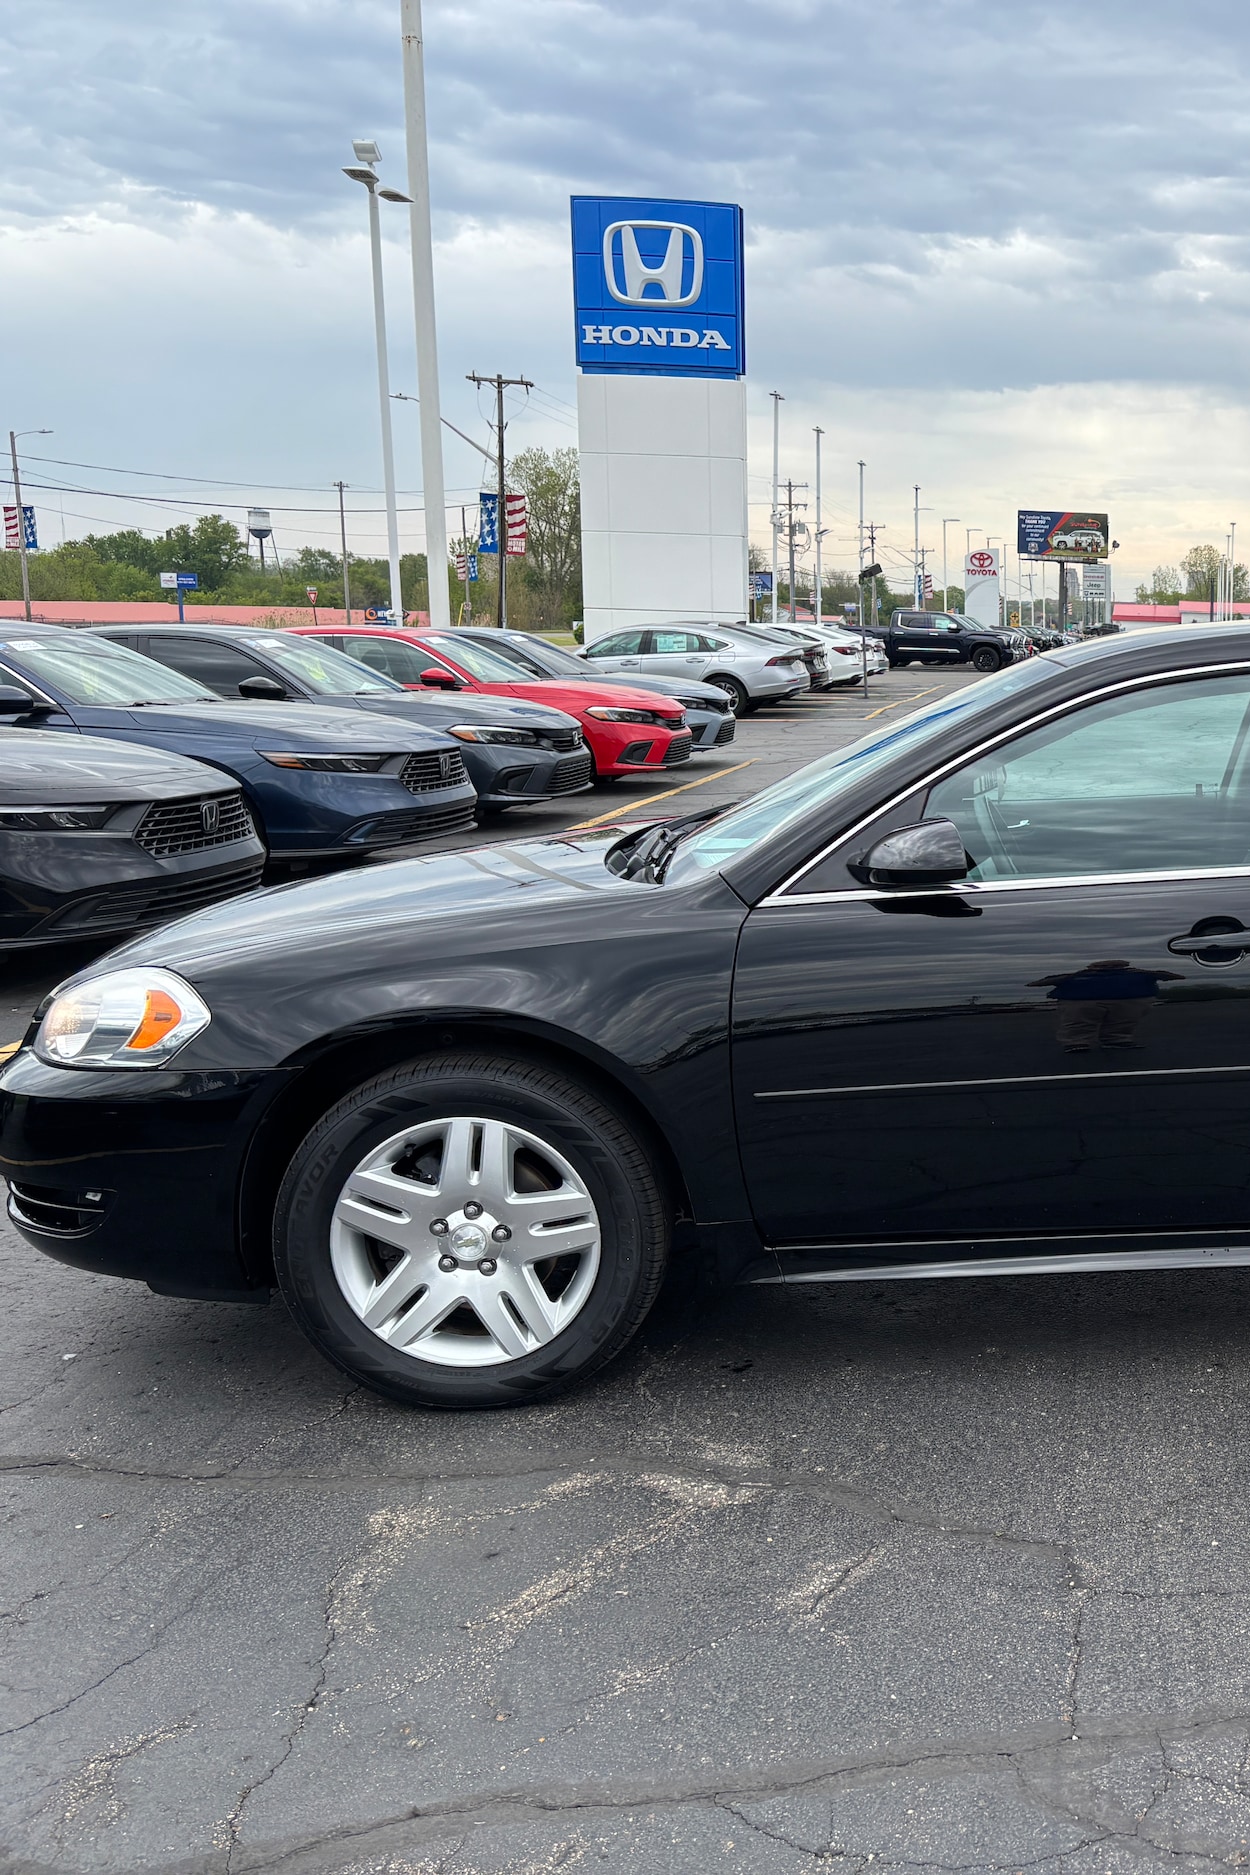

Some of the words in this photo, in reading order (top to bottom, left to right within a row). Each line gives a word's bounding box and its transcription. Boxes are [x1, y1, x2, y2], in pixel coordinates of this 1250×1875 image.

[581, 324, 732, 350] HONDA
[966, 568, 998, 577] TOYOTA
[1086, 581, 1102, 589] Jeep
